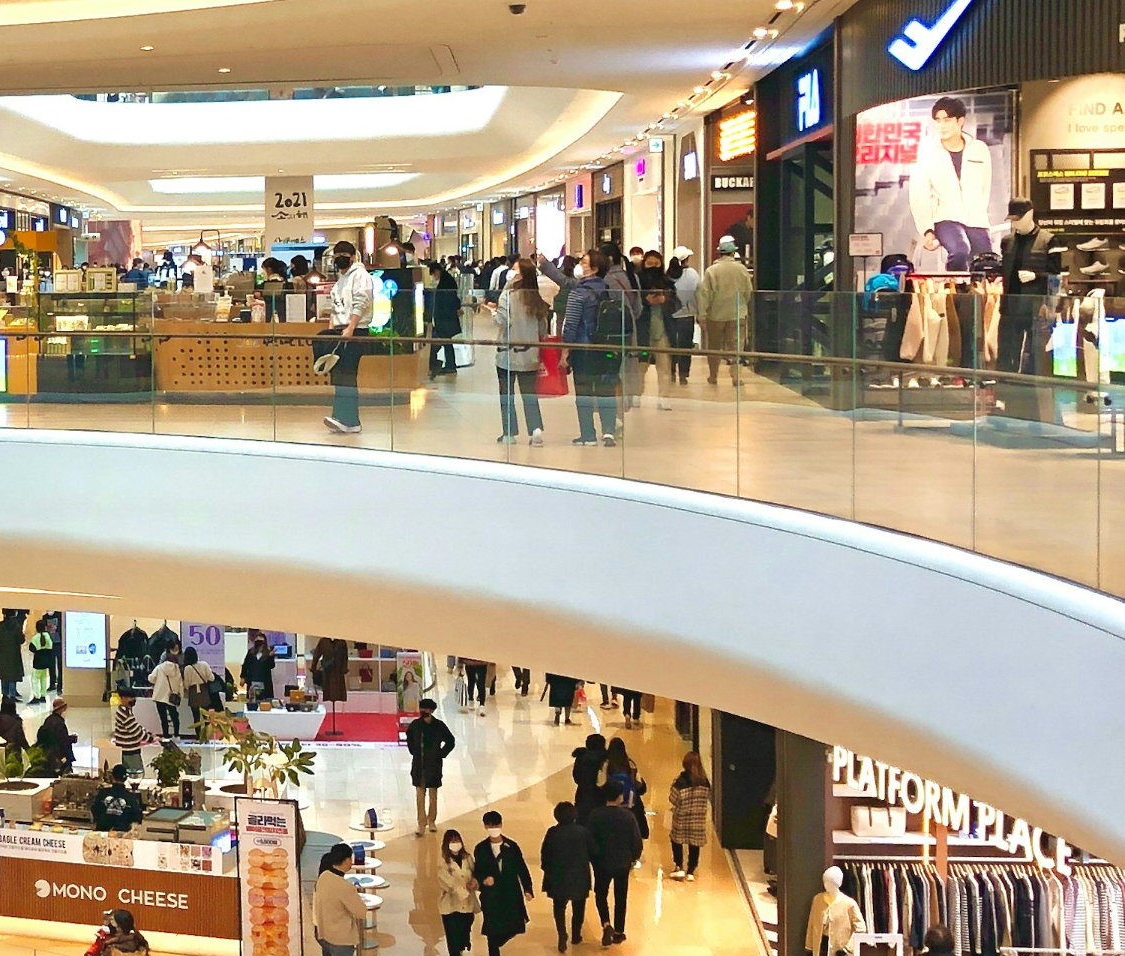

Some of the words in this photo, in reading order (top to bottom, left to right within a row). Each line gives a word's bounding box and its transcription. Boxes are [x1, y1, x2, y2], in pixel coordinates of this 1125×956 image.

[1068, 102, 1106, 116] FIND
[1075, 123, 1099, 133] love
[274, 192, 308, 208] 2021
[188, 625, 221, 646] 50
[832, 745, 971, 835] PLATFORM
[972, 799, 1073, 877] PLACE
[18, 836, 42, 847] CREAM
[42, 838, 67, 849] CHEESE
[51, 882, 107, 902] MONO
[117, 888, 190, 910] CHEESE
